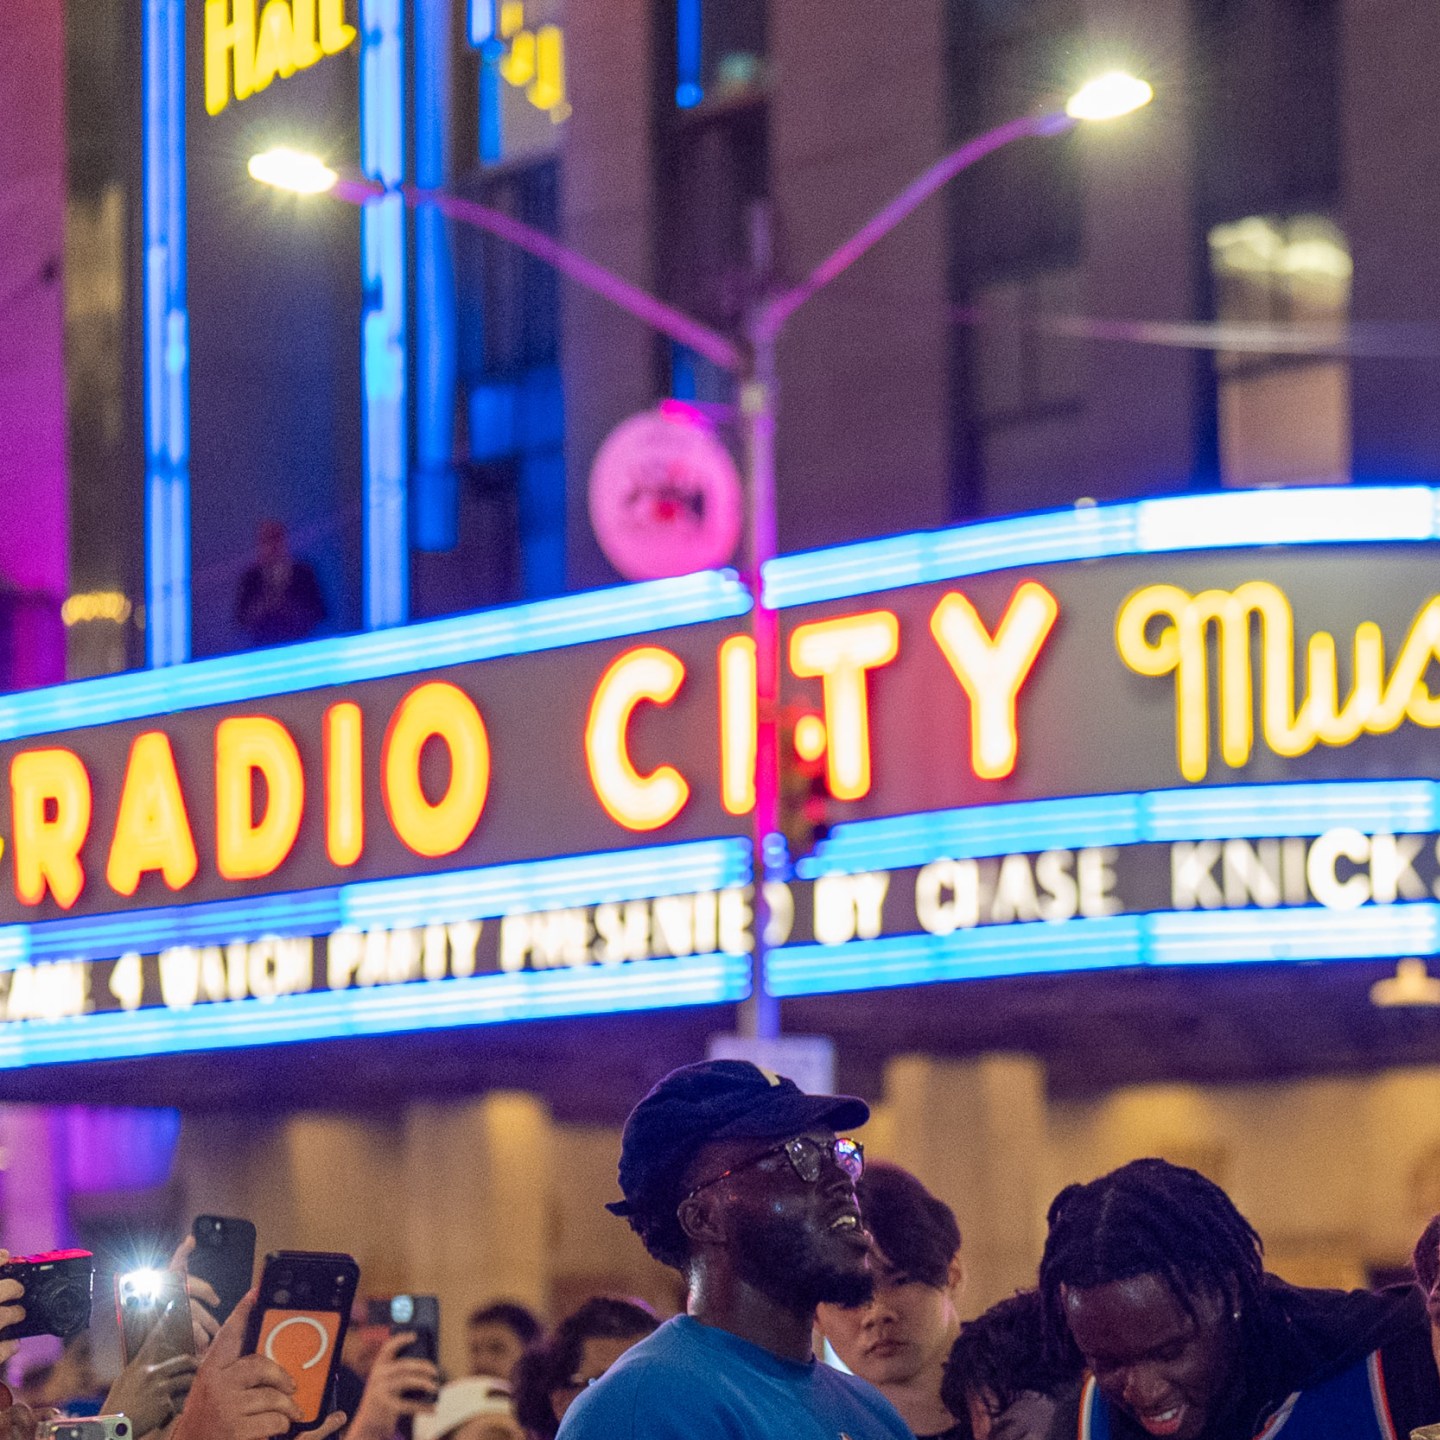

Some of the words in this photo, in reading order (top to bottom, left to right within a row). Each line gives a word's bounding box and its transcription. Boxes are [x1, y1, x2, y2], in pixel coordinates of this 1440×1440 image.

[9, 680, 491, 910] RADIO
[585, 580, 1059, 832] CITY
[914, 846, 1126, 936] CHASE
